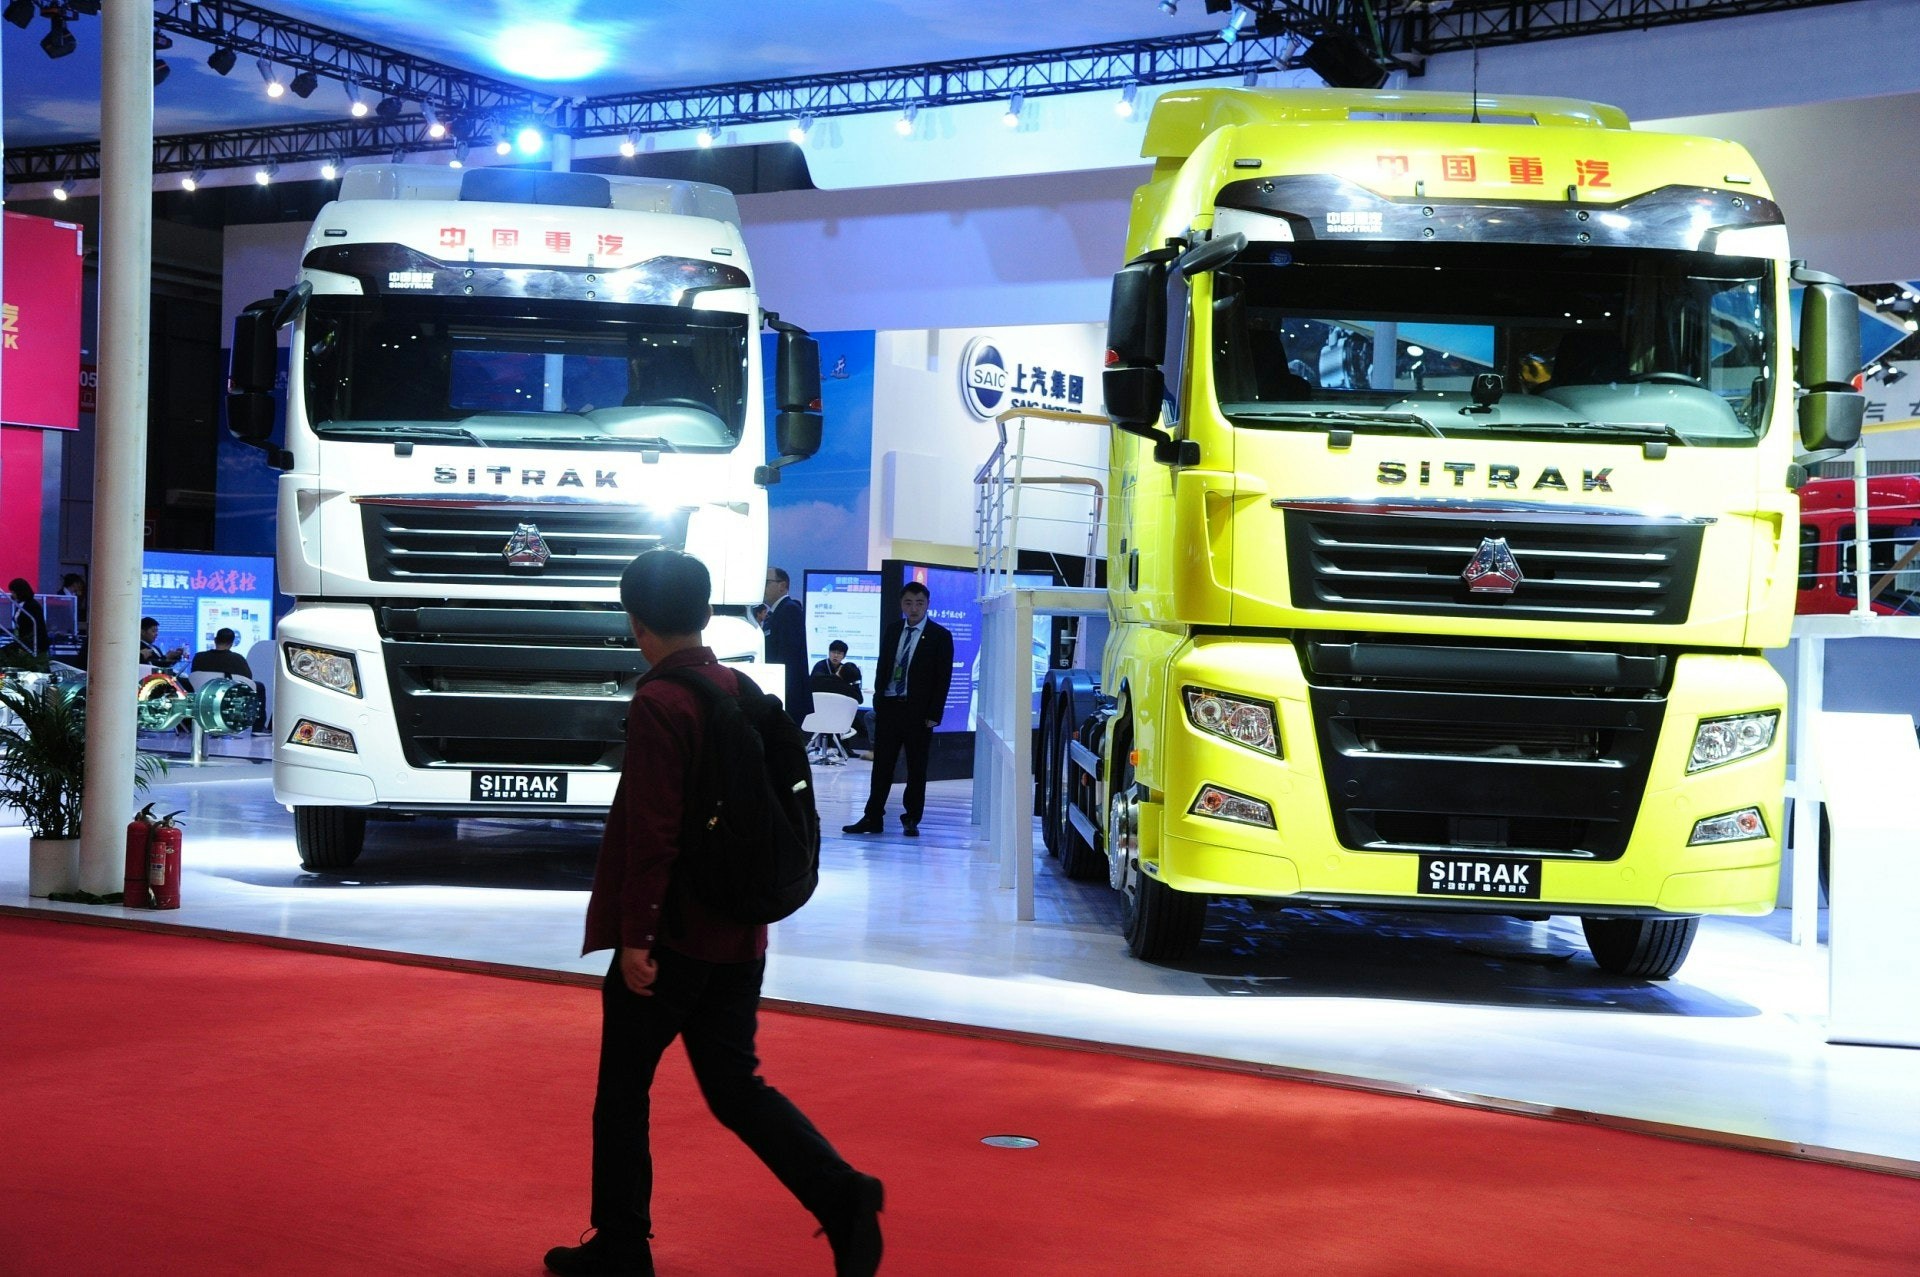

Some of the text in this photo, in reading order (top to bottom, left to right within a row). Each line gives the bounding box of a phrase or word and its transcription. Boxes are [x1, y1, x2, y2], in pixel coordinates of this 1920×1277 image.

[439, 227, 624, 256] 中国重汽
[973, 369, 1007, 389] SAIC
[1010, 363, 1084, 404] 上汽集团
[433, 463, 619, 489] SITRAK
[1376, 460, 1615, 493] SITRAK
[479, 774, 559, 791] SITRAK
[1429, 860, 1530, 885] SITRAK
